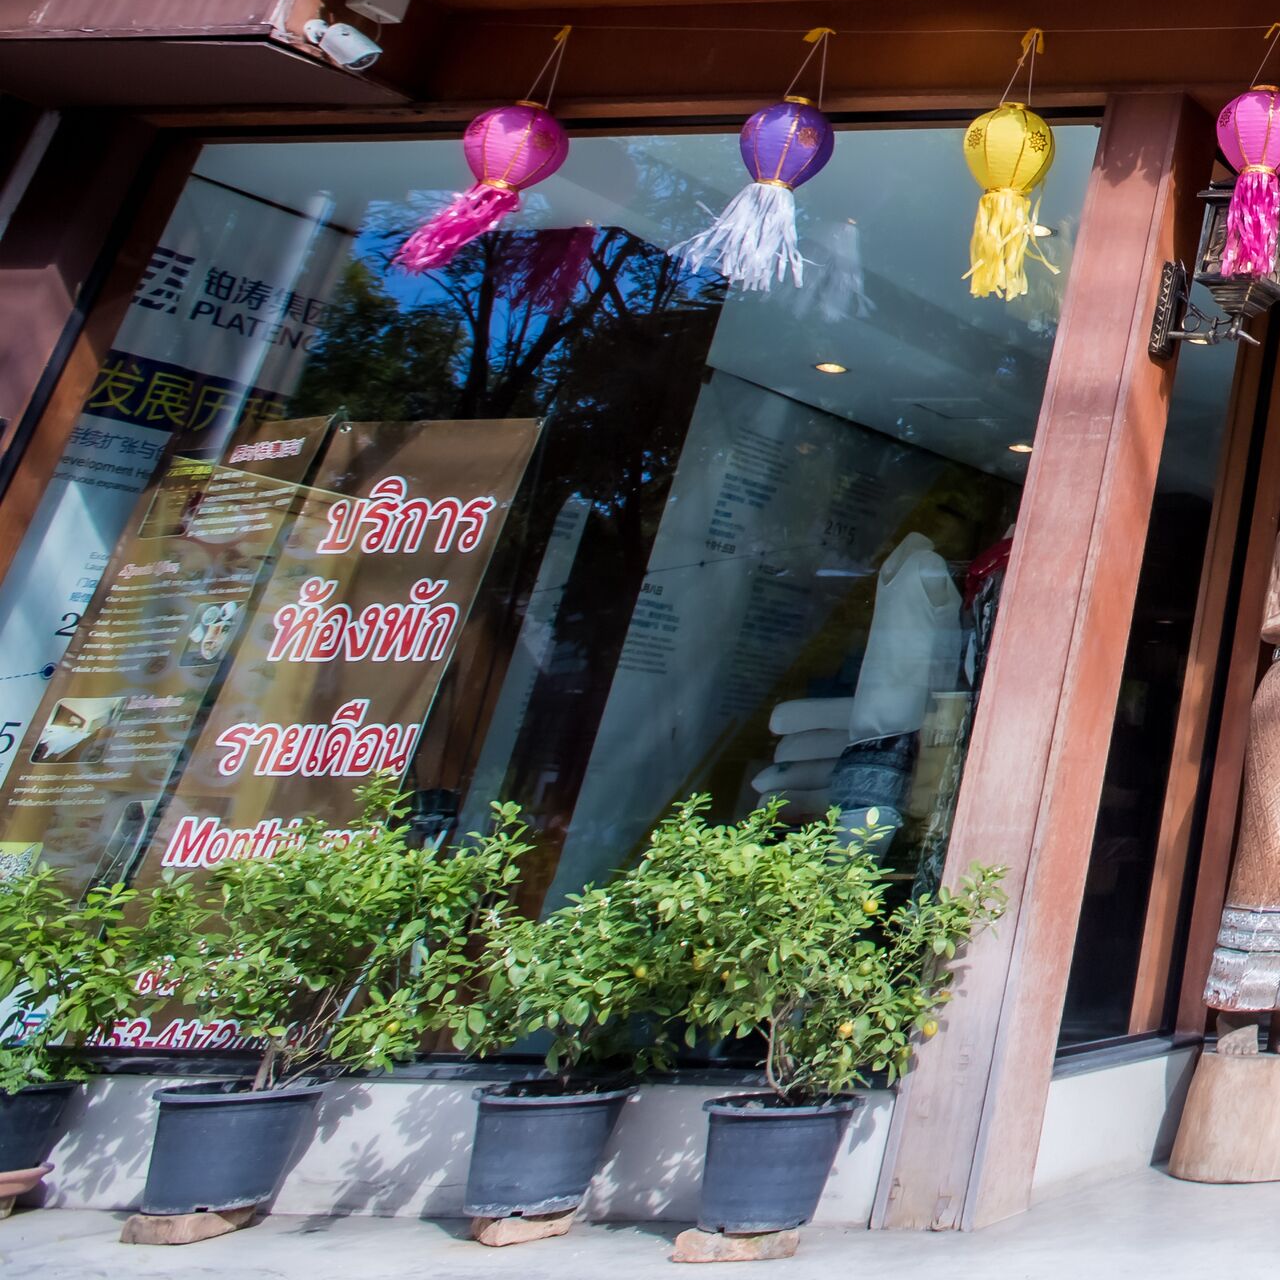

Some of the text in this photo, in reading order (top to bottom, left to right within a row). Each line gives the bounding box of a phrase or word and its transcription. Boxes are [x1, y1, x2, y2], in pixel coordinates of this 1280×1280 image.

[61, 454, 134, 476] evelopment
[317, 475, 496, 555] บริการ
[267, 576, 459, 663] ห้องพัก
[216, 699, 421, 777] รายเดือน
[162, 816, 307, 868] Monthl
